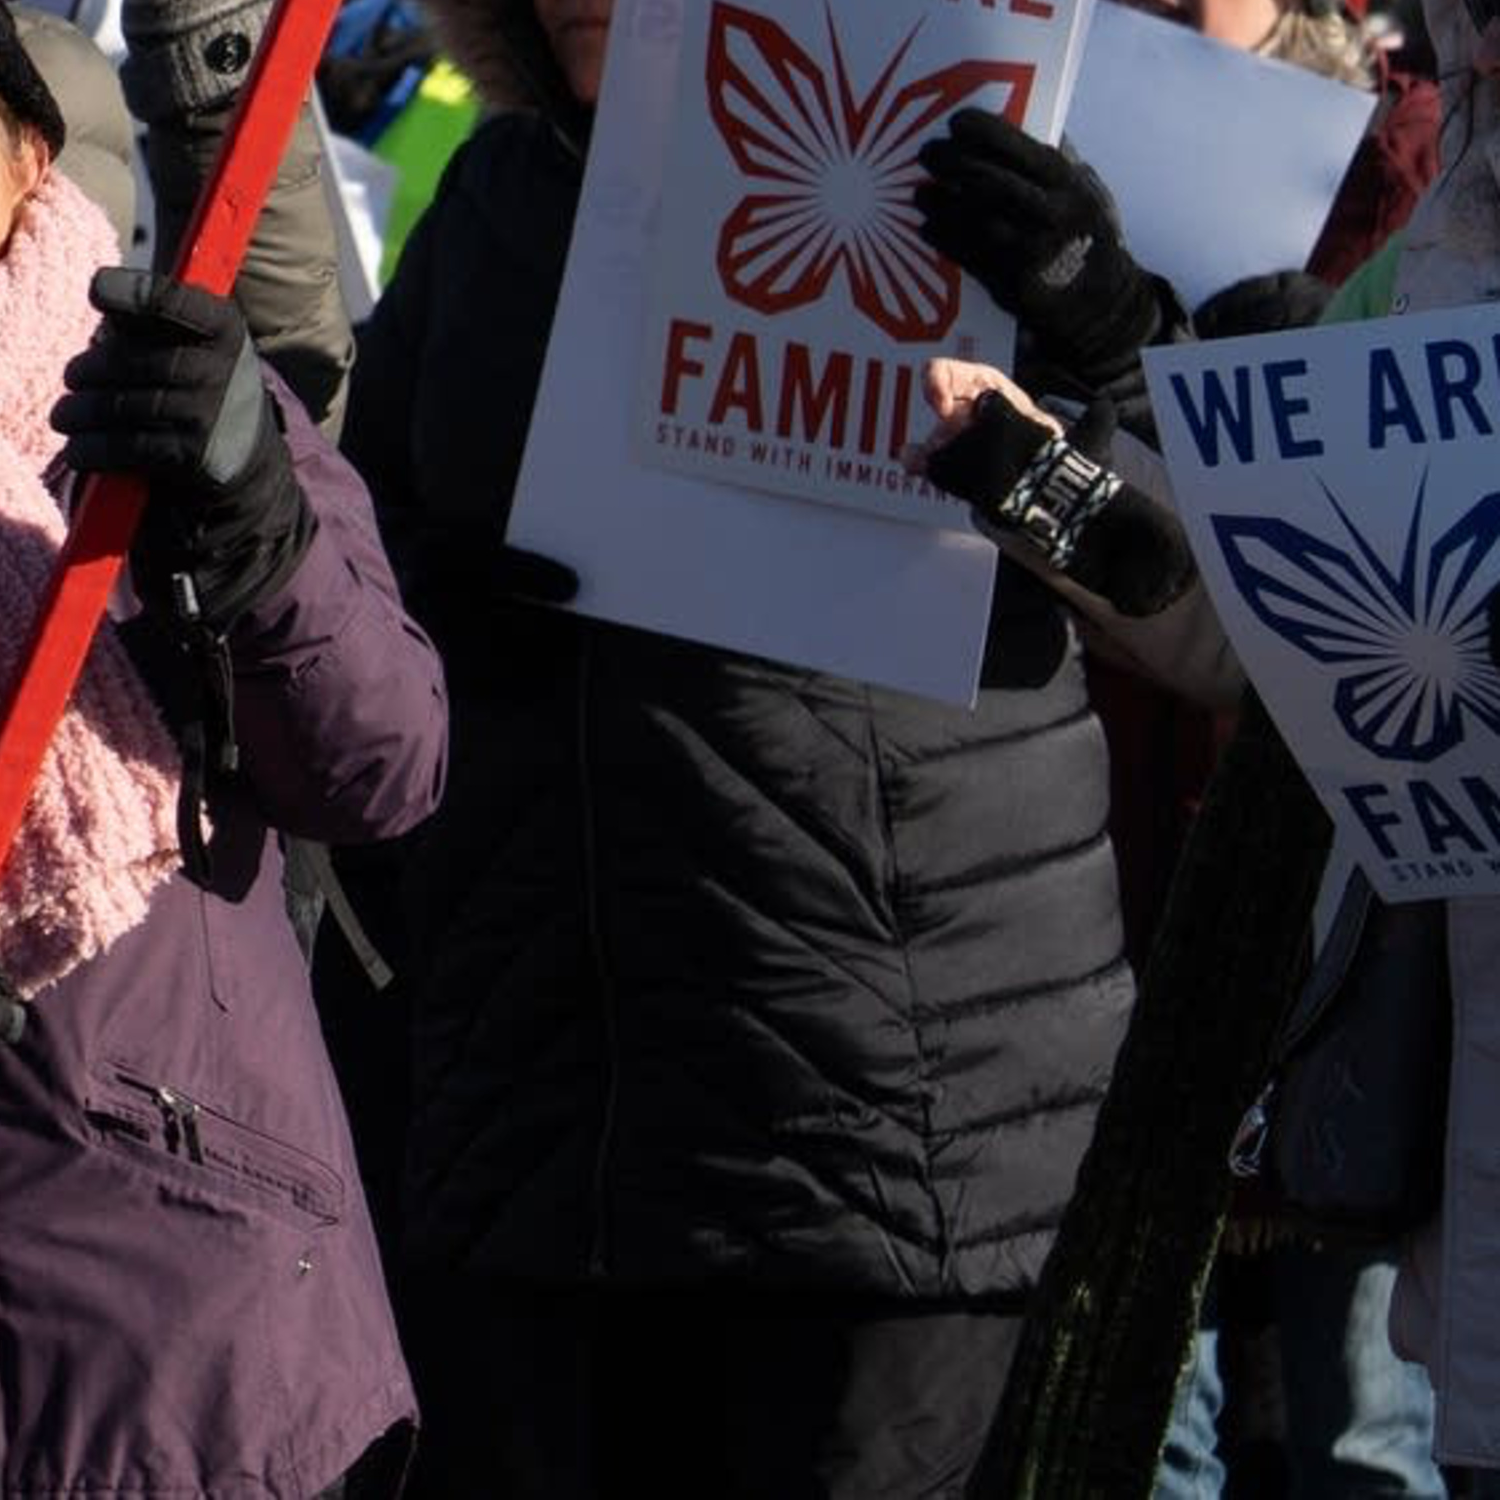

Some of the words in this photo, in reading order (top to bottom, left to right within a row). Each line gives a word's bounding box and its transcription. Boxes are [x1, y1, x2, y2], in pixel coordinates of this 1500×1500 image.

[656, 422, 736, 458] STAND
[750, 439, 811, 478] WITH
[1169, 358, 1324, 469] WE
[1368, 338, 1500, 450] AR
